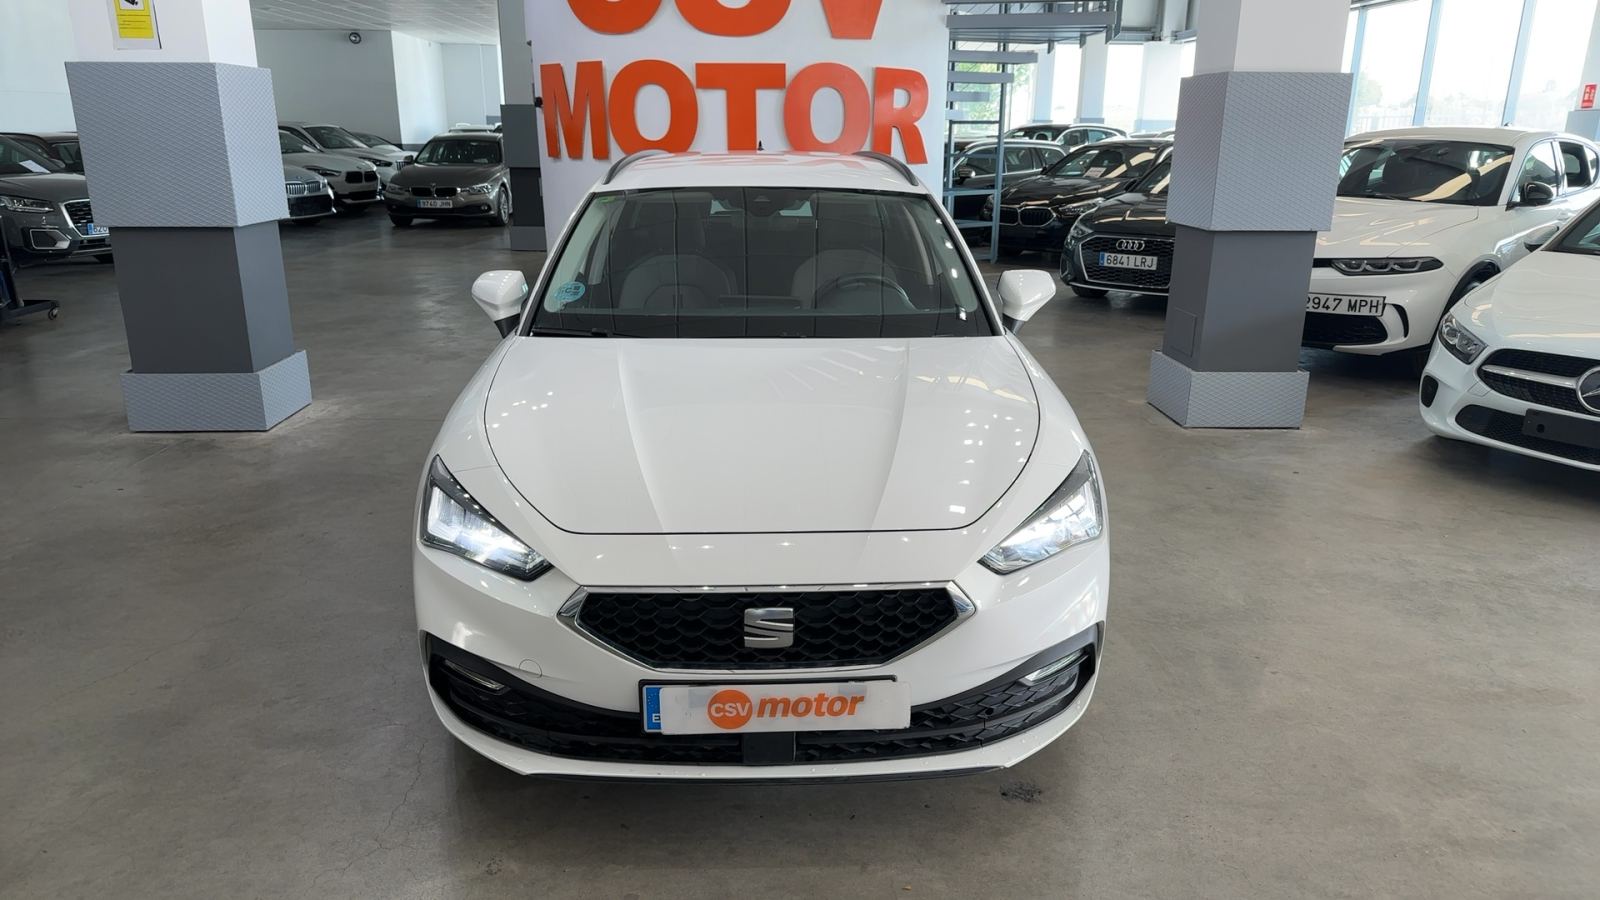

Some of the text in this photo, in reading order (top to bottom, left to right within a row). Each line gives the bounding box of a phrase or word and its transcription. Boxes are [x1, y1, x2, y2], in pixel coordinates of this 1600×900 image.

[540, 60, 929, 164] MOTOR
[1106, 254, 1154, 268] 6841 LRJ
[1347, 298, 1380, 314] MPH
[757, 693, 865, 718] motor
